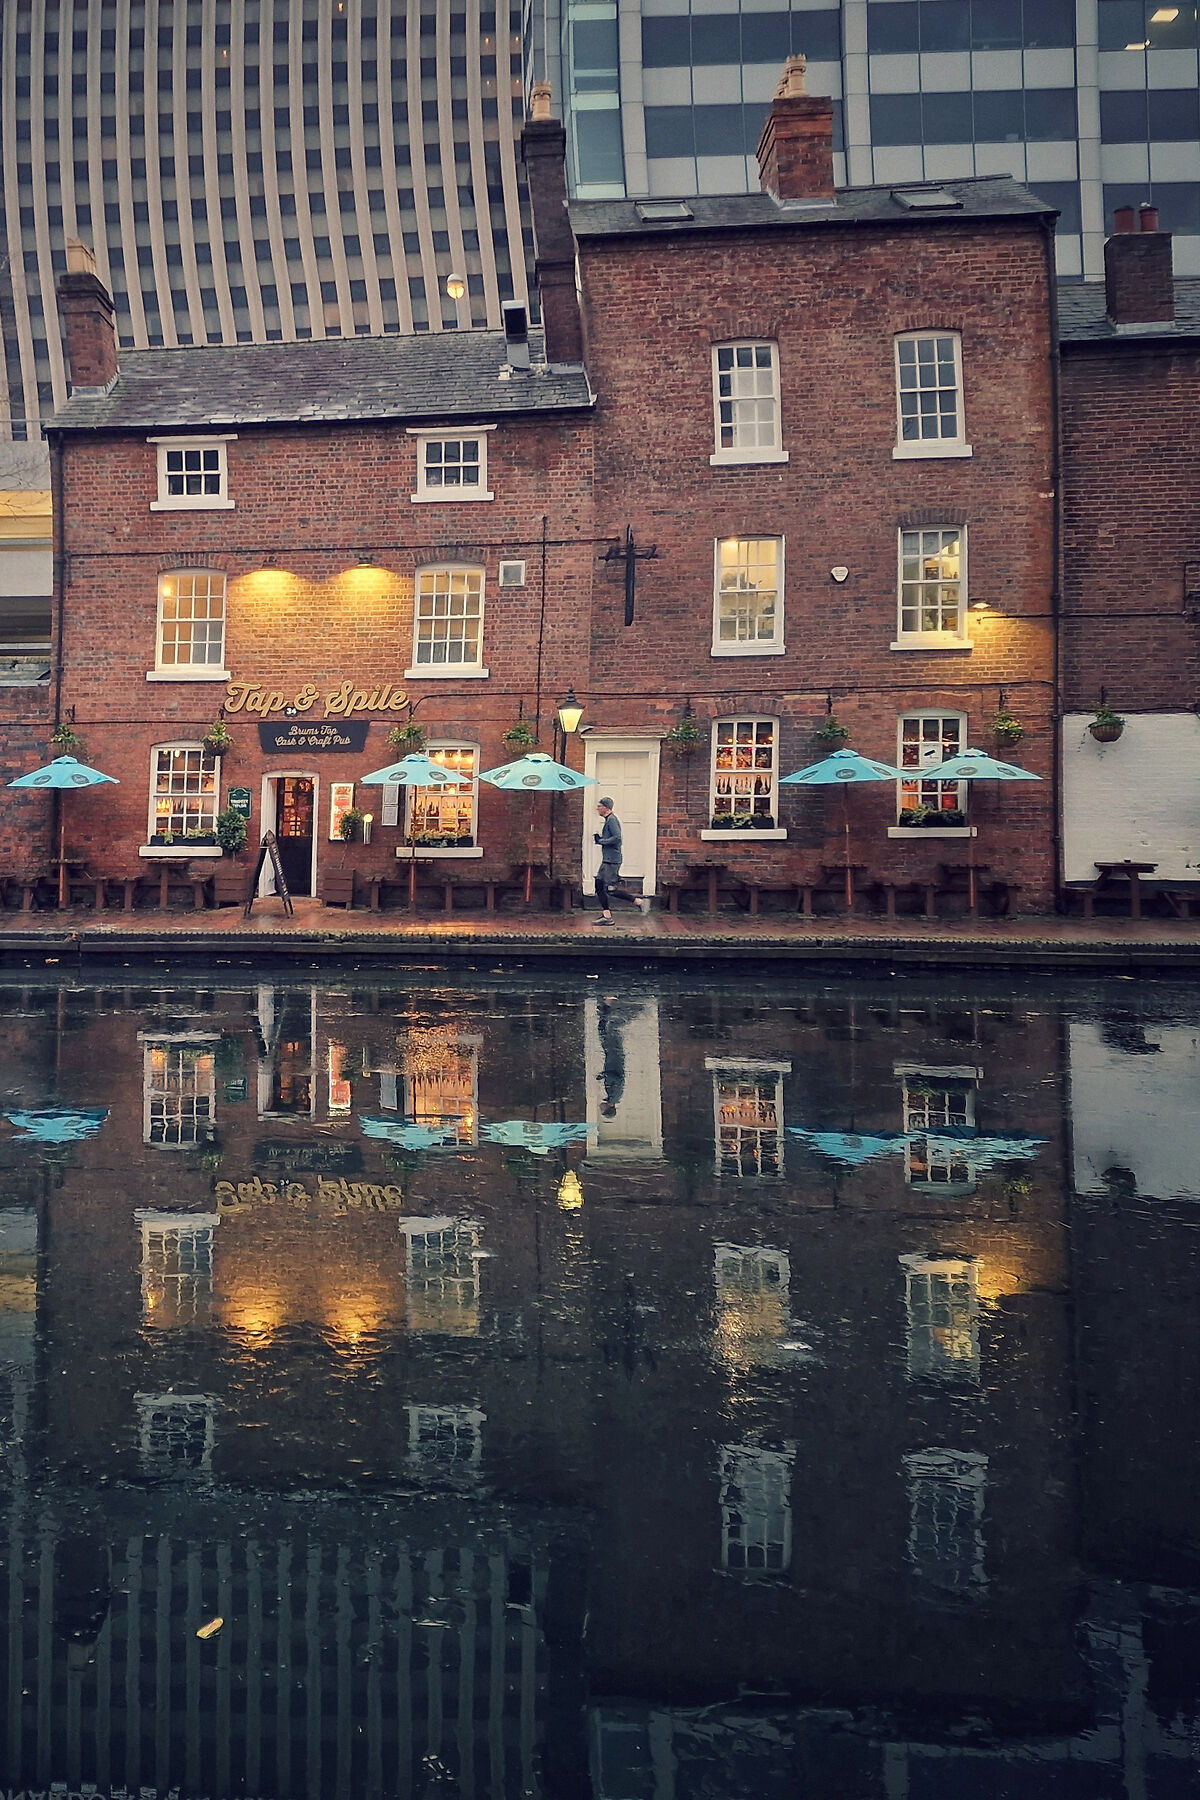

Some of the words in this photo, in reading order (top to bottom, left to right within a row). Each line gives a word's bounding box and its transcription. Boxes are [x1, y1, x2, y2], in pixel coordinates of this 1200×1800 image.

[224, 682, 288, 718] Tap
[294, 683, 320, 712] &
[323, 679, 409, 719] Spile
[289, 725, 318, 736] Brums
[320, 725, 338, 736] Tap
[275, 736, 296, 747] Cask
[298, 736, 306, 745] &
[308, 736, 332, 748] Craft
[333, 736, 351, 746] Pub
